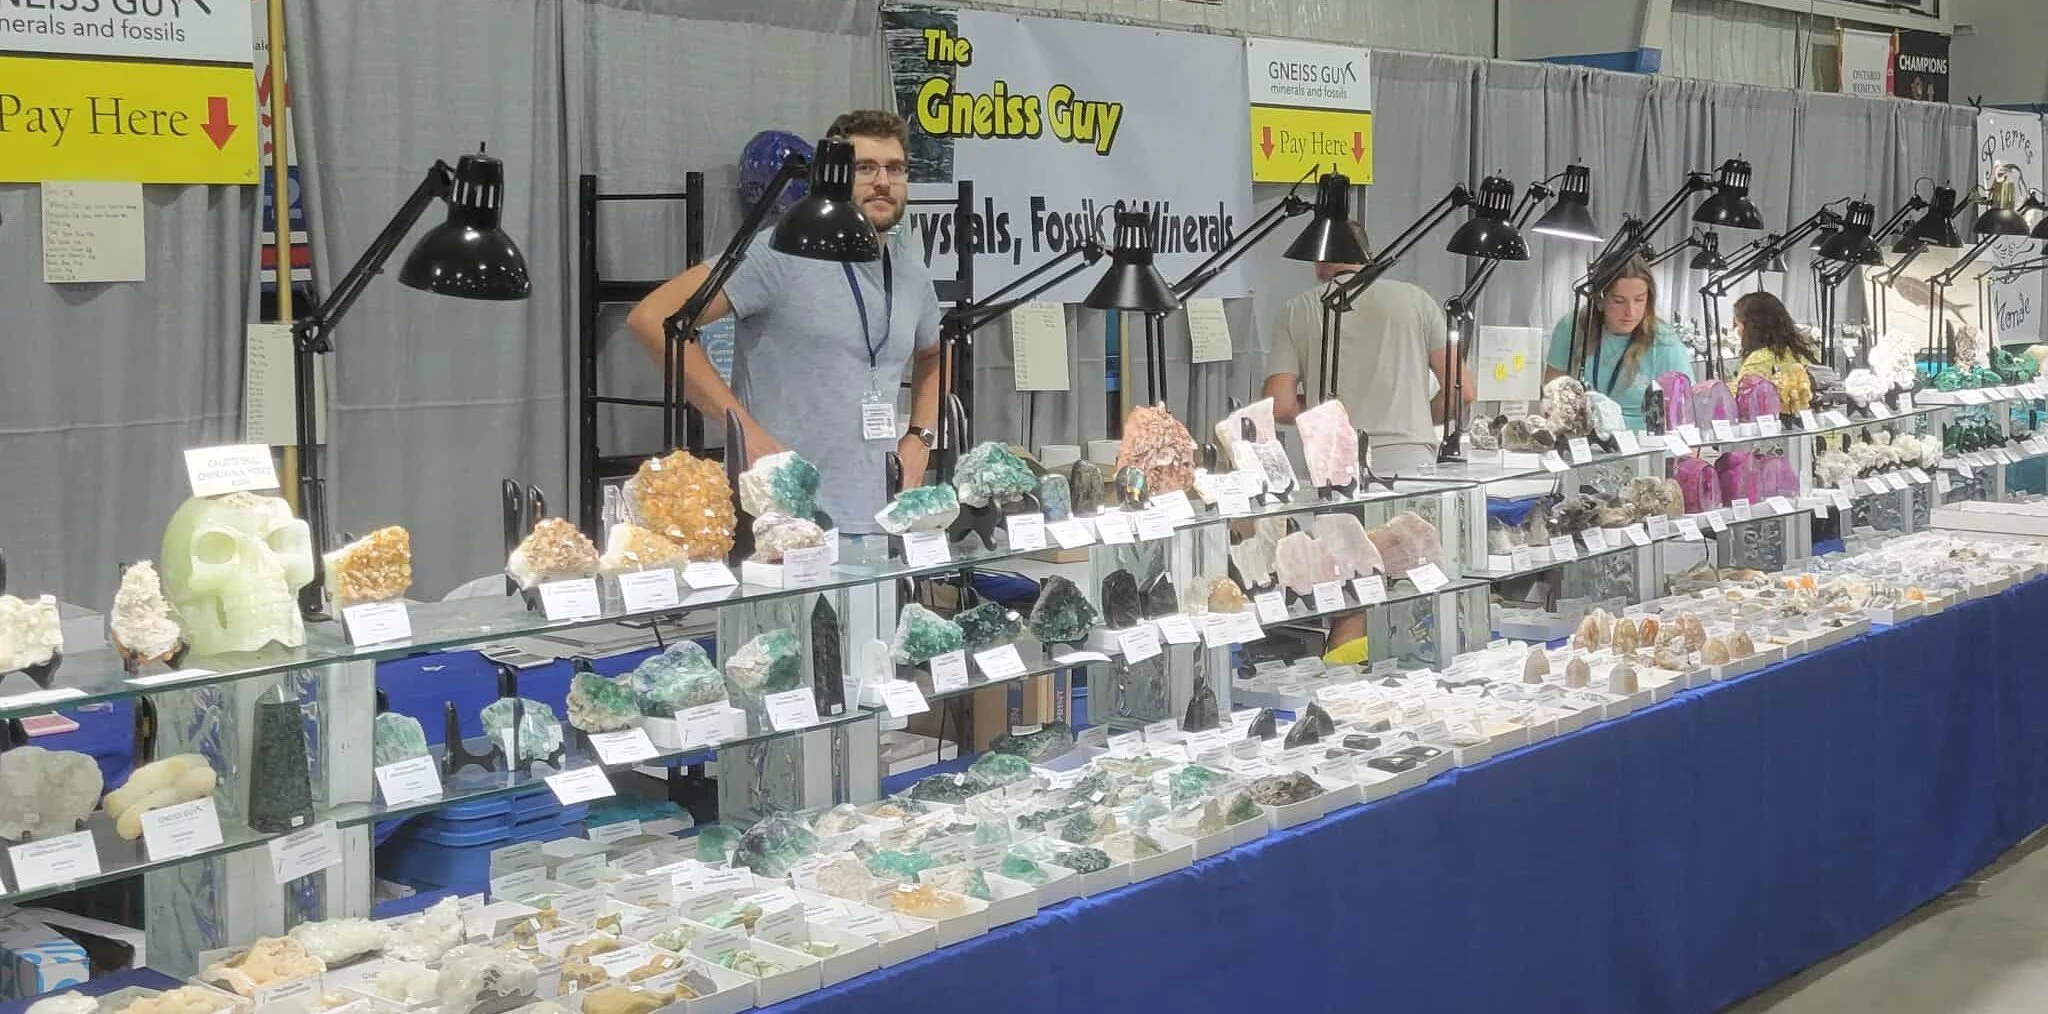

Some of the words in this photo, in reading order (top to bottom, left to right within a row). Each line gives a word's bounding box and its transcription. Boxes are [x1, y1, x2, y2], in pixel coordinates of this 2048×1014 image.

[72, 18, 115, 38] and
[121, 18, 186, 42] fossils
[923, 28, 972, 66] The
[1268, 61, 1318, 82] GNEISS
[1321, 65, 1347, 84] GUY
[1899, 54, 1948, 75] CHAMPIONS
[1270, 83, 1305, 97] minerals
[1307, 86, 1322, 98] and
[1324, 86, 1348, 99] fossils
[0, 93, 73, 147] Pay
[86, 96, 189, 136] Here
[916, 76, 1042, 139] Gneiss
[1047, 83, 1124, 156] Guy
[1280, 130, 1307, 162] Pay
[1312, 131, 1348, 156] Here
